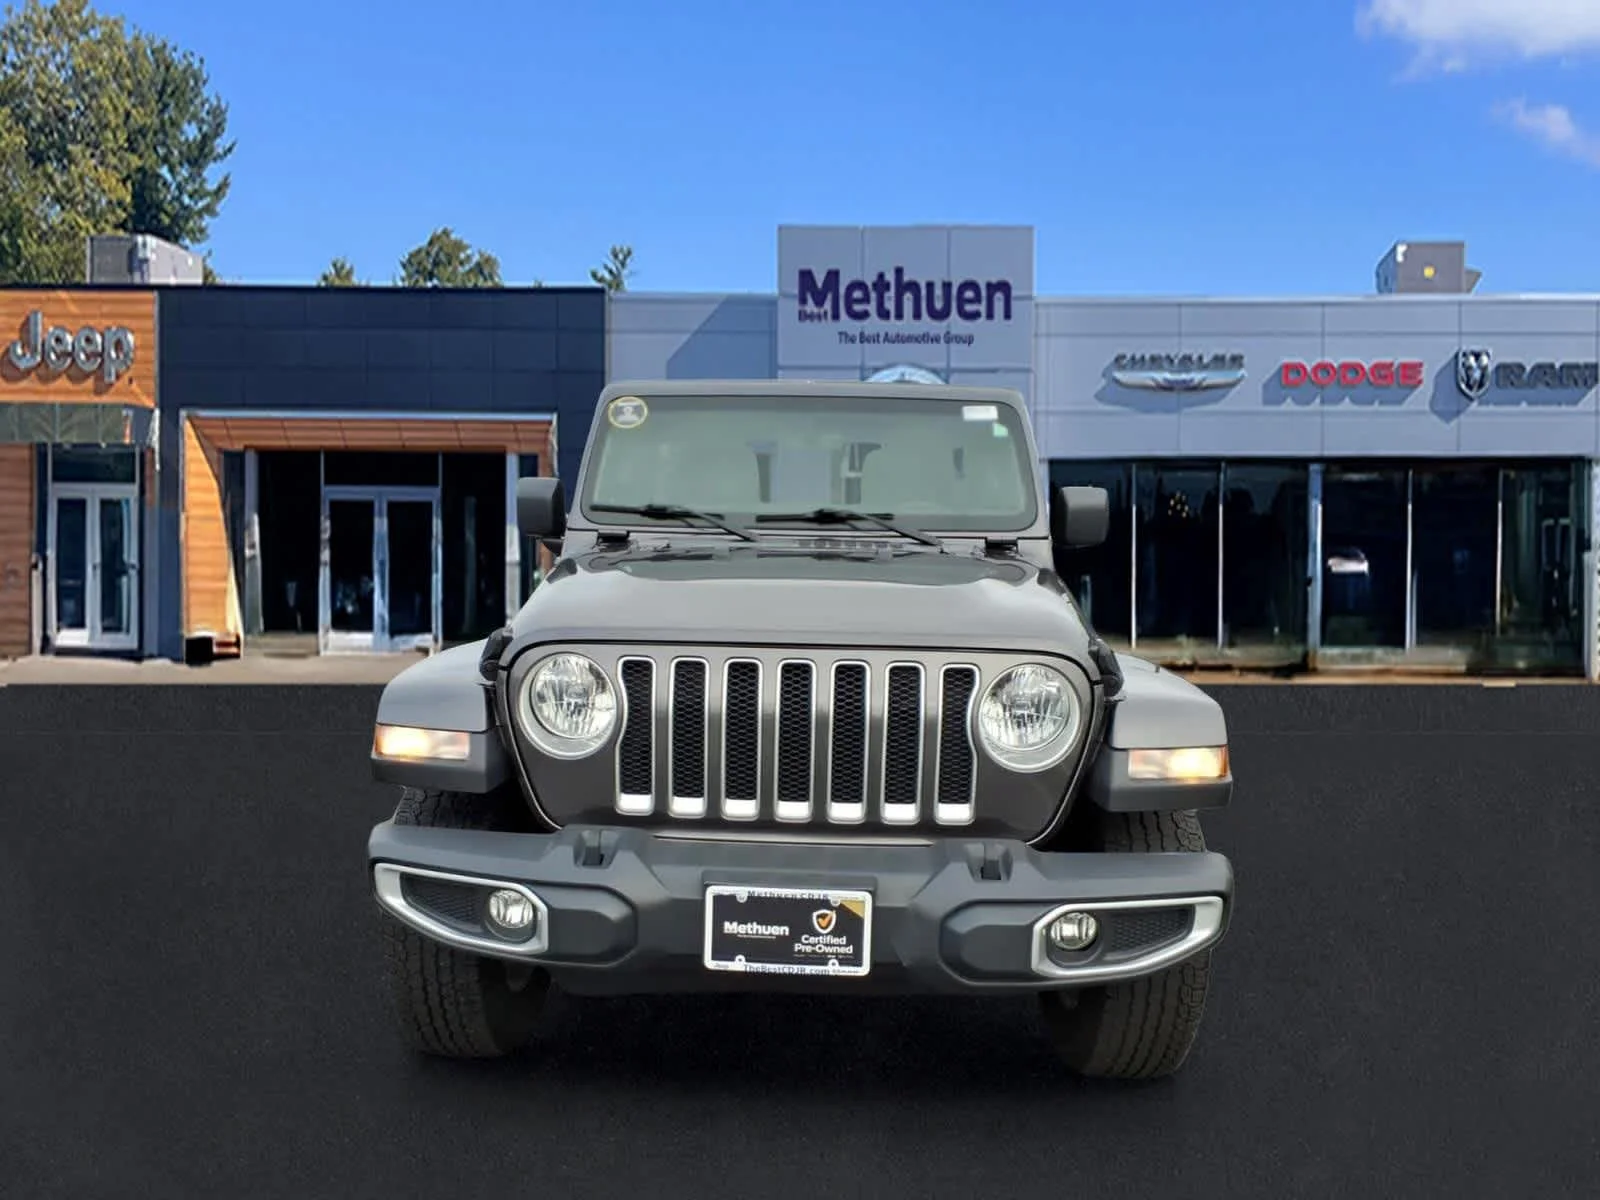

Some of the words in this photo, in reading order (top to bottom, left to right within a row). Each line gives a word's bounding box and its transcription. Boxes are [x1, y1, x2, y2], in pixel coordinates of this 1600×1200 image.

[798, 266, 1012, 320] Methuen
[798, 309, 828, 322] Best
[10, 309, 135, 383] Jeep
[838, 331, 857, 344] The
[859, 332, 881, 344] Best
[883, 331, 941, 344] Automotive
[943, 331, 975, 346] Group
[1113, 353, 1245, 369] CHRYSLER
[1281, 361, 1424, 387] DODGE
[1495, 362, 1599, 389] RAM
[723, 921, 790, 936] Methuen
[801, 934, 847, 945] Certified
[794, 943, 853, 954] Pre-Owned
